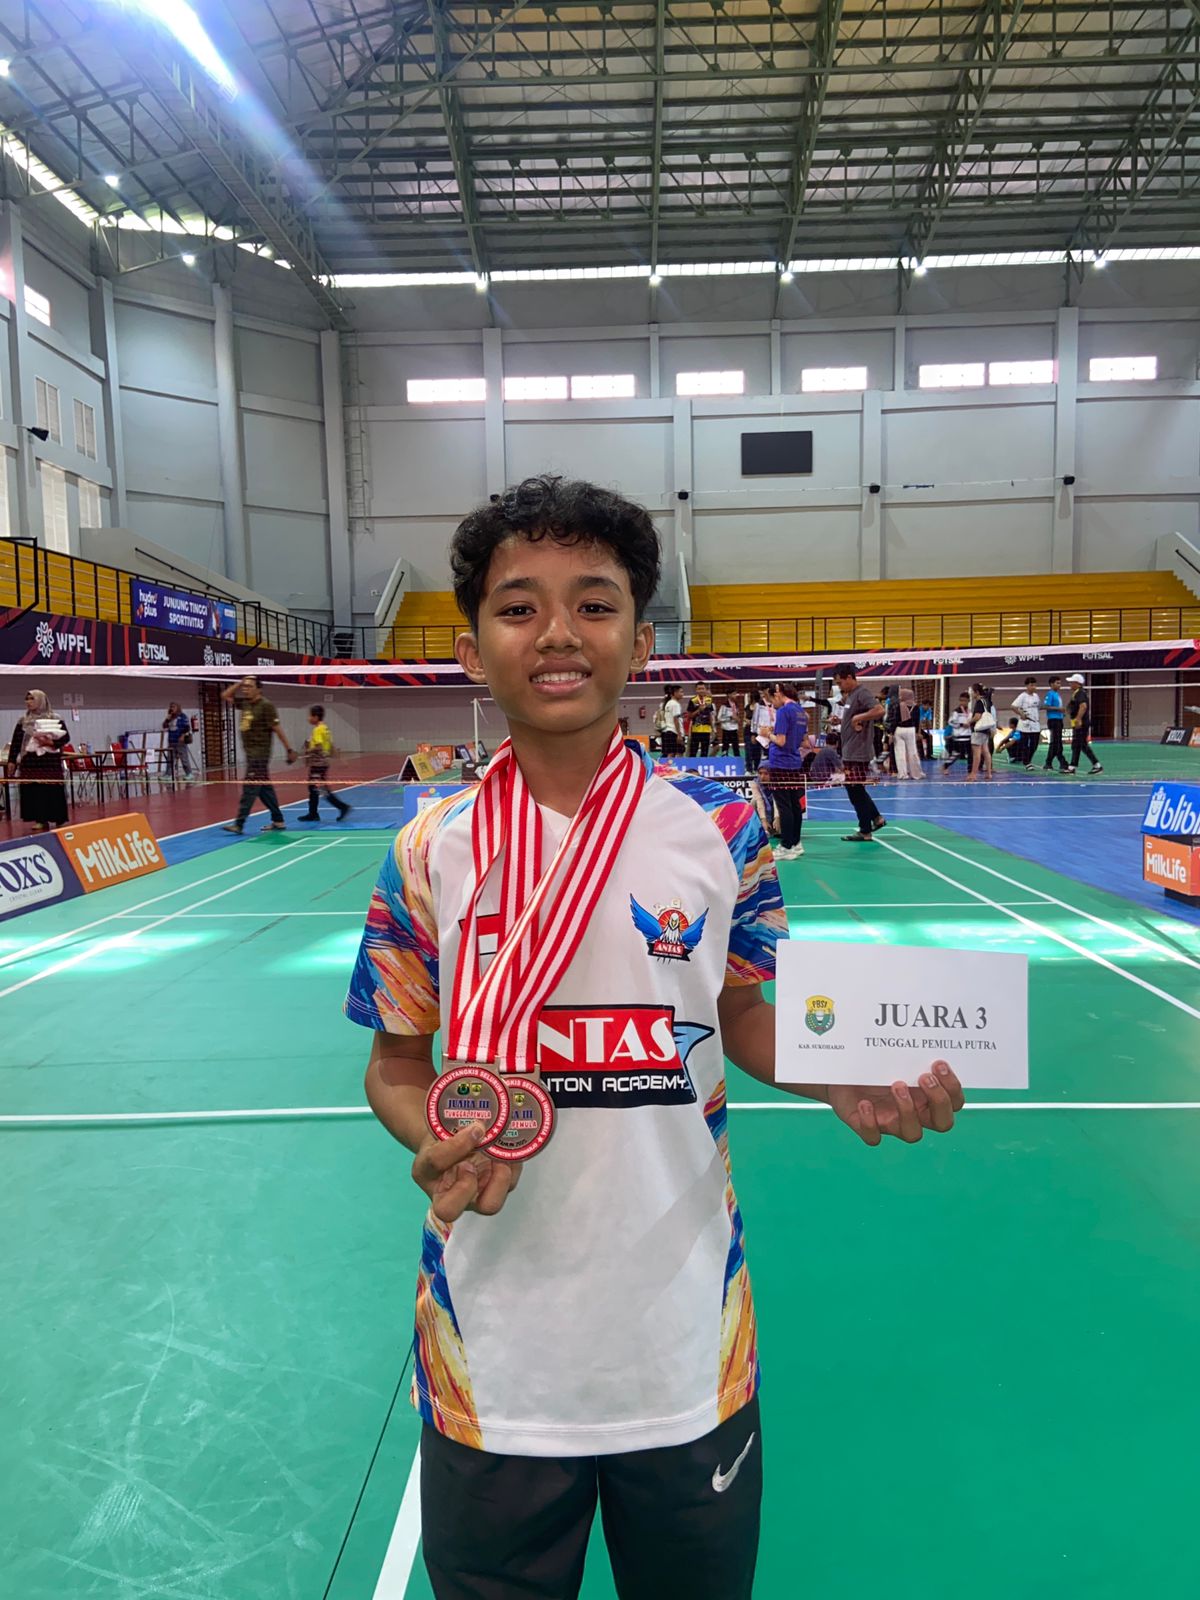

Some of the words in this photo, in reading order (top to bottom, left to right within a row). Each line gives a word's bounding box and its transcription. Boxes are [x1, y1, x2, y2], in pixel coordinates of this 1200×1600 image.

[143, 605, 158, 618] plus
[163, 596, 189, 612] JUNJUNG
[189, 602, 208, 616] TINGGI
[169, 612, 204, 629] SPORTIVITAS
[56, 632, 92, 653] WPFL
[138, 643, 169, 661] FUTSAL
[214, 652, 234, 666] WPFL
[1082, 652, 1113, 660] FUTSAL
[933, 657, 964, 665] FUTSAL
[723, 780, 745, 788] KOPI
[75, 830, 159, 883] MilkLife
[1146, 852, 1187, 883] MilkLife
[655, 943, 683, 954] ANTAS
[811, 1000, 828, 1008] PBSI
[874, 1002, 968, 1029] JUARA
[975, 1006, 988, 1030] 3
[537, 1016, 677, 1063] NTAS
[864, 1037, 919, 1049] TUNGGAL
[921, 1038, 962, 1050] PEMULA
[964, 1040, 997, 1050] PUTRA
[541, 1077, 593, 1092] NTON
[602, 1074, 687, 1092] ACADEMY
[438, 1068, 479, 1089] BULUTANGKIS
[480, 1070, 503, 1092] SELURUH
[497, 1092, 508, 1127] INDONESIA
[448, 1099, 476, 1109] JUARA
[479, 1100, 490, 1109] III
[522, 1080, 545, 1101] SELURUH
[541, 1101, 552, 1136] INDONESIA
[523, 1110, 533, 1119] III
[511, 1120, 538, 1129] PEMULA
